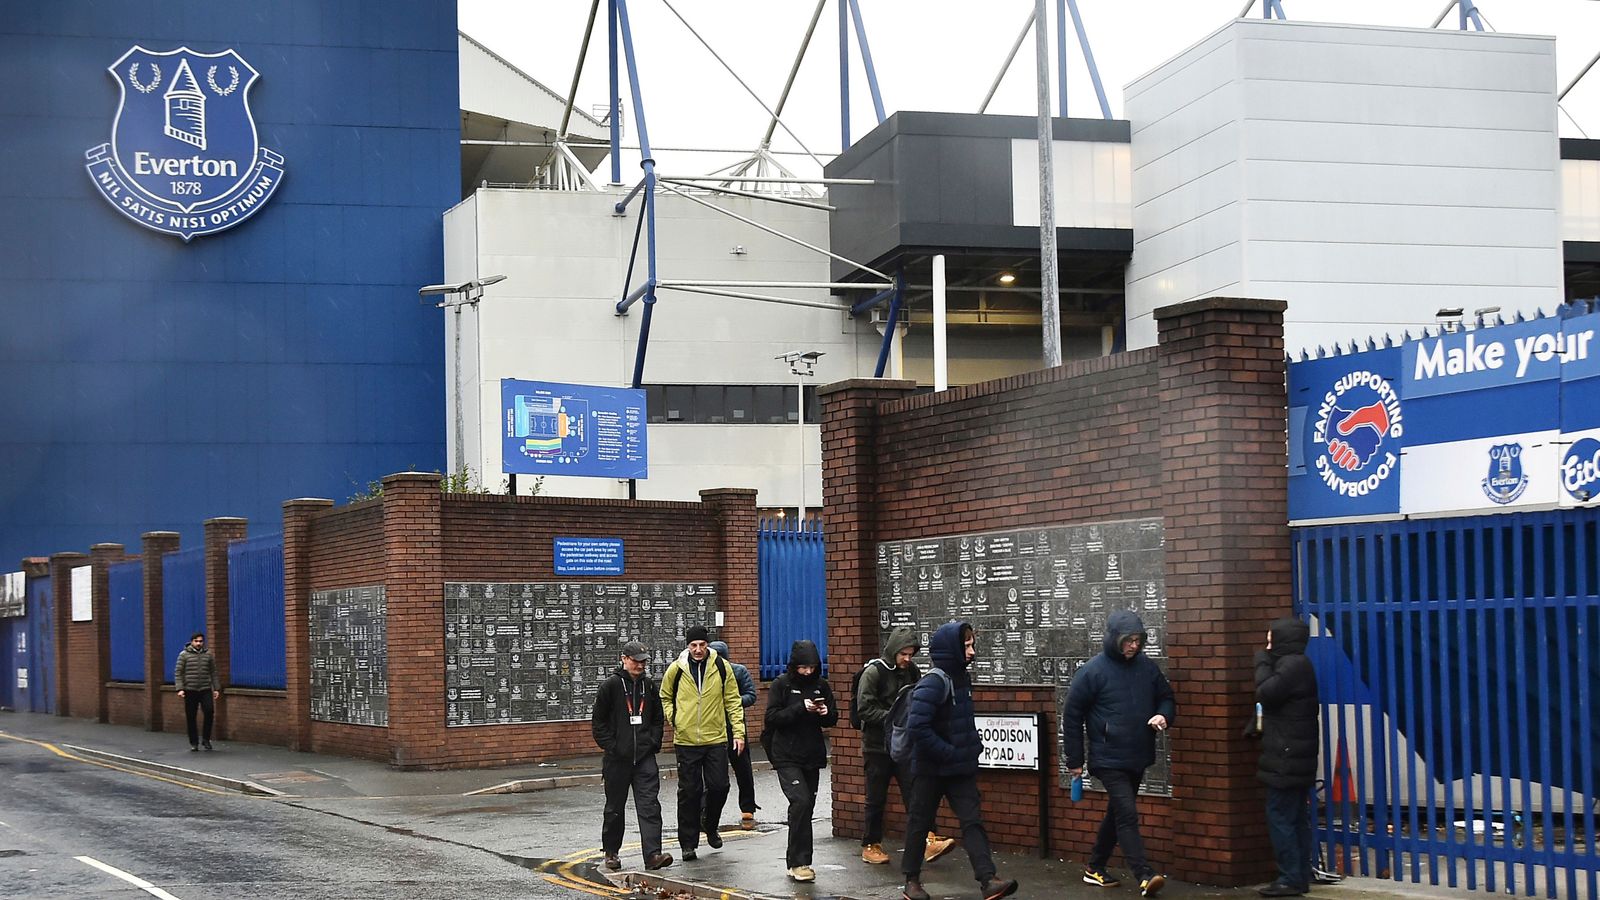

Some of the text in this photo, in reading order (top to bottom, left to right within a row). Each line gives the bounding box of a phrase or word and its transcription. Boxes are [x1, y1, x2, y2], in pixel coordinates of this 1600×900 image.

[134, 151, 237, 177] Everton
[99, 171, 273, 228] NIL SATIS NISI OPTIMUM
[170, 181, 202, 195] 1878
[1414, 329, 1594, 380] Make your
[1314, 371, 1403, 443] FANS SUPPORTING
[1315, 451, 1397, 498] FOODBANKS
[977, 728, 1032, 743] GOODISON
[987, 719, 996, 728] City
[1001, 719, 1020, 728] Liverpool
[984, 746, 1025, 761] ROAD L4
